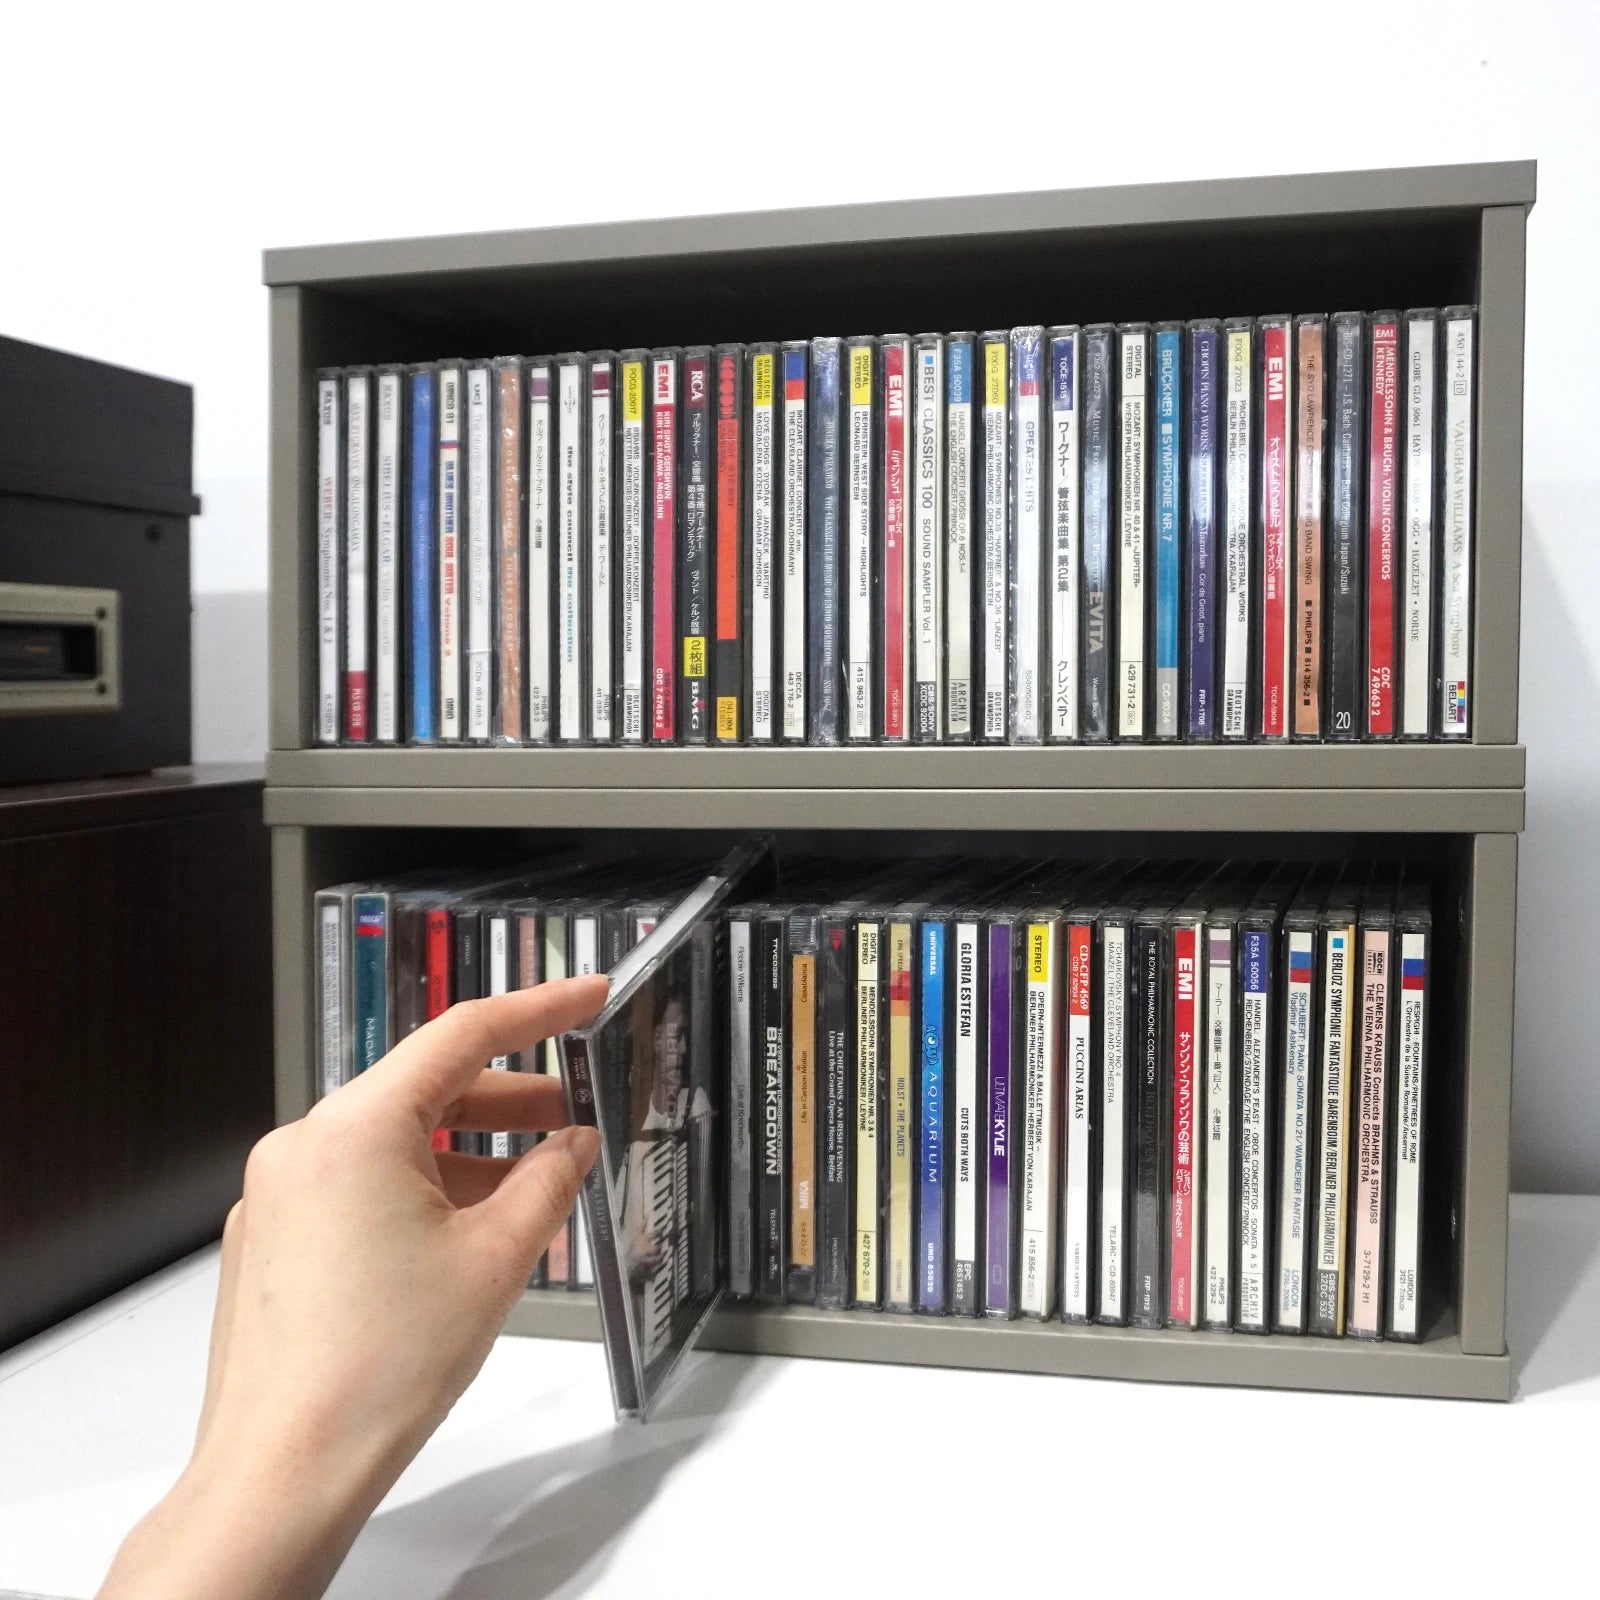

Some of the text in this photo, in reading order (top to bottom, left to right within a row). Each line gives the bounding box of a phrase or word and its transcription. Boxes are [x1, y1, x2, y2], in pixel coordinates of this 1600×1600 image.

[658, 364, 669, 398] EMI
[691, 371, 702, 400] RCA
[954, 374, 962, 402] 50039
[1269, 357, 1282, 400] EMI
[1376, 347, 1384, 394] KENNEDY
[324, 390, 332, 425] NAXOS
[889, 375, 902, 416] EMI
[1059, 422, 1069, 476] ワーグナー
[1162, 350, 1172, 508] BRUCKNER SYMPHONIE
[1382, 347, 1394, 579] MENDELSSOHN BRUCH: VIOLIN CONCERTOS
[1454, 421, 1464, 484] VAUGHAN
[922, 367, 934, 612] BEST CLASSICS 100 SOUND SAMPLER
[1340, 409, 1351, 594] Bach: Cantatas Japan/Suzuki
[1090, 591, 1104, 653] EVITA
[1382, 668, 1390, 688] CDC
[958, 683, 966, 722] ARCHIV
[1336, 712, 1350, 728] 20
[1448, 685, 1456, 720] BELART
[1080, 988, 1088, 1009] 4569
[1179, 958, 1192, 1000] EMI
[1298, 992, 1306, 1041] SCHUBERT:
[1375, 984, 1383, 1029] CLEMENS
[960, 943, 971, 1182] GLORIA ESTEFAN CUTS BOTH WAYS
[1076, 1037, 1084, 1083] PUCCINI
[1288, 1030, 1297, 1074] Ashkenazy
[1374, 1034, 1382, 1072] KRAUSS
[766, 1027, 776, 1174] BREAKDOWN
[1361, 984, 1374, 1182] THE VIENNA PHILHARMONIC ORCHESTRA
[928, 1073, 936, 1182] AQUARIUM
[1323, 953, 1343, 1264] BERLIOZ SYMPHONIE FANTASTIQUE BARENBOIM/BERLINER PHILHARMONIKER
[994, 1119, 1004, 1156] KYLIE
[1370, 1124, 1379, 1165] BRAHMS
[799, 1181, 809, 1209] MIKA
[1370, 1179, 1378, 1224] STRAUSS
[1292, 1197, 1300, 1238] FANTASIE
[1362, 1250, 1371, 1288] 3-7129-2
